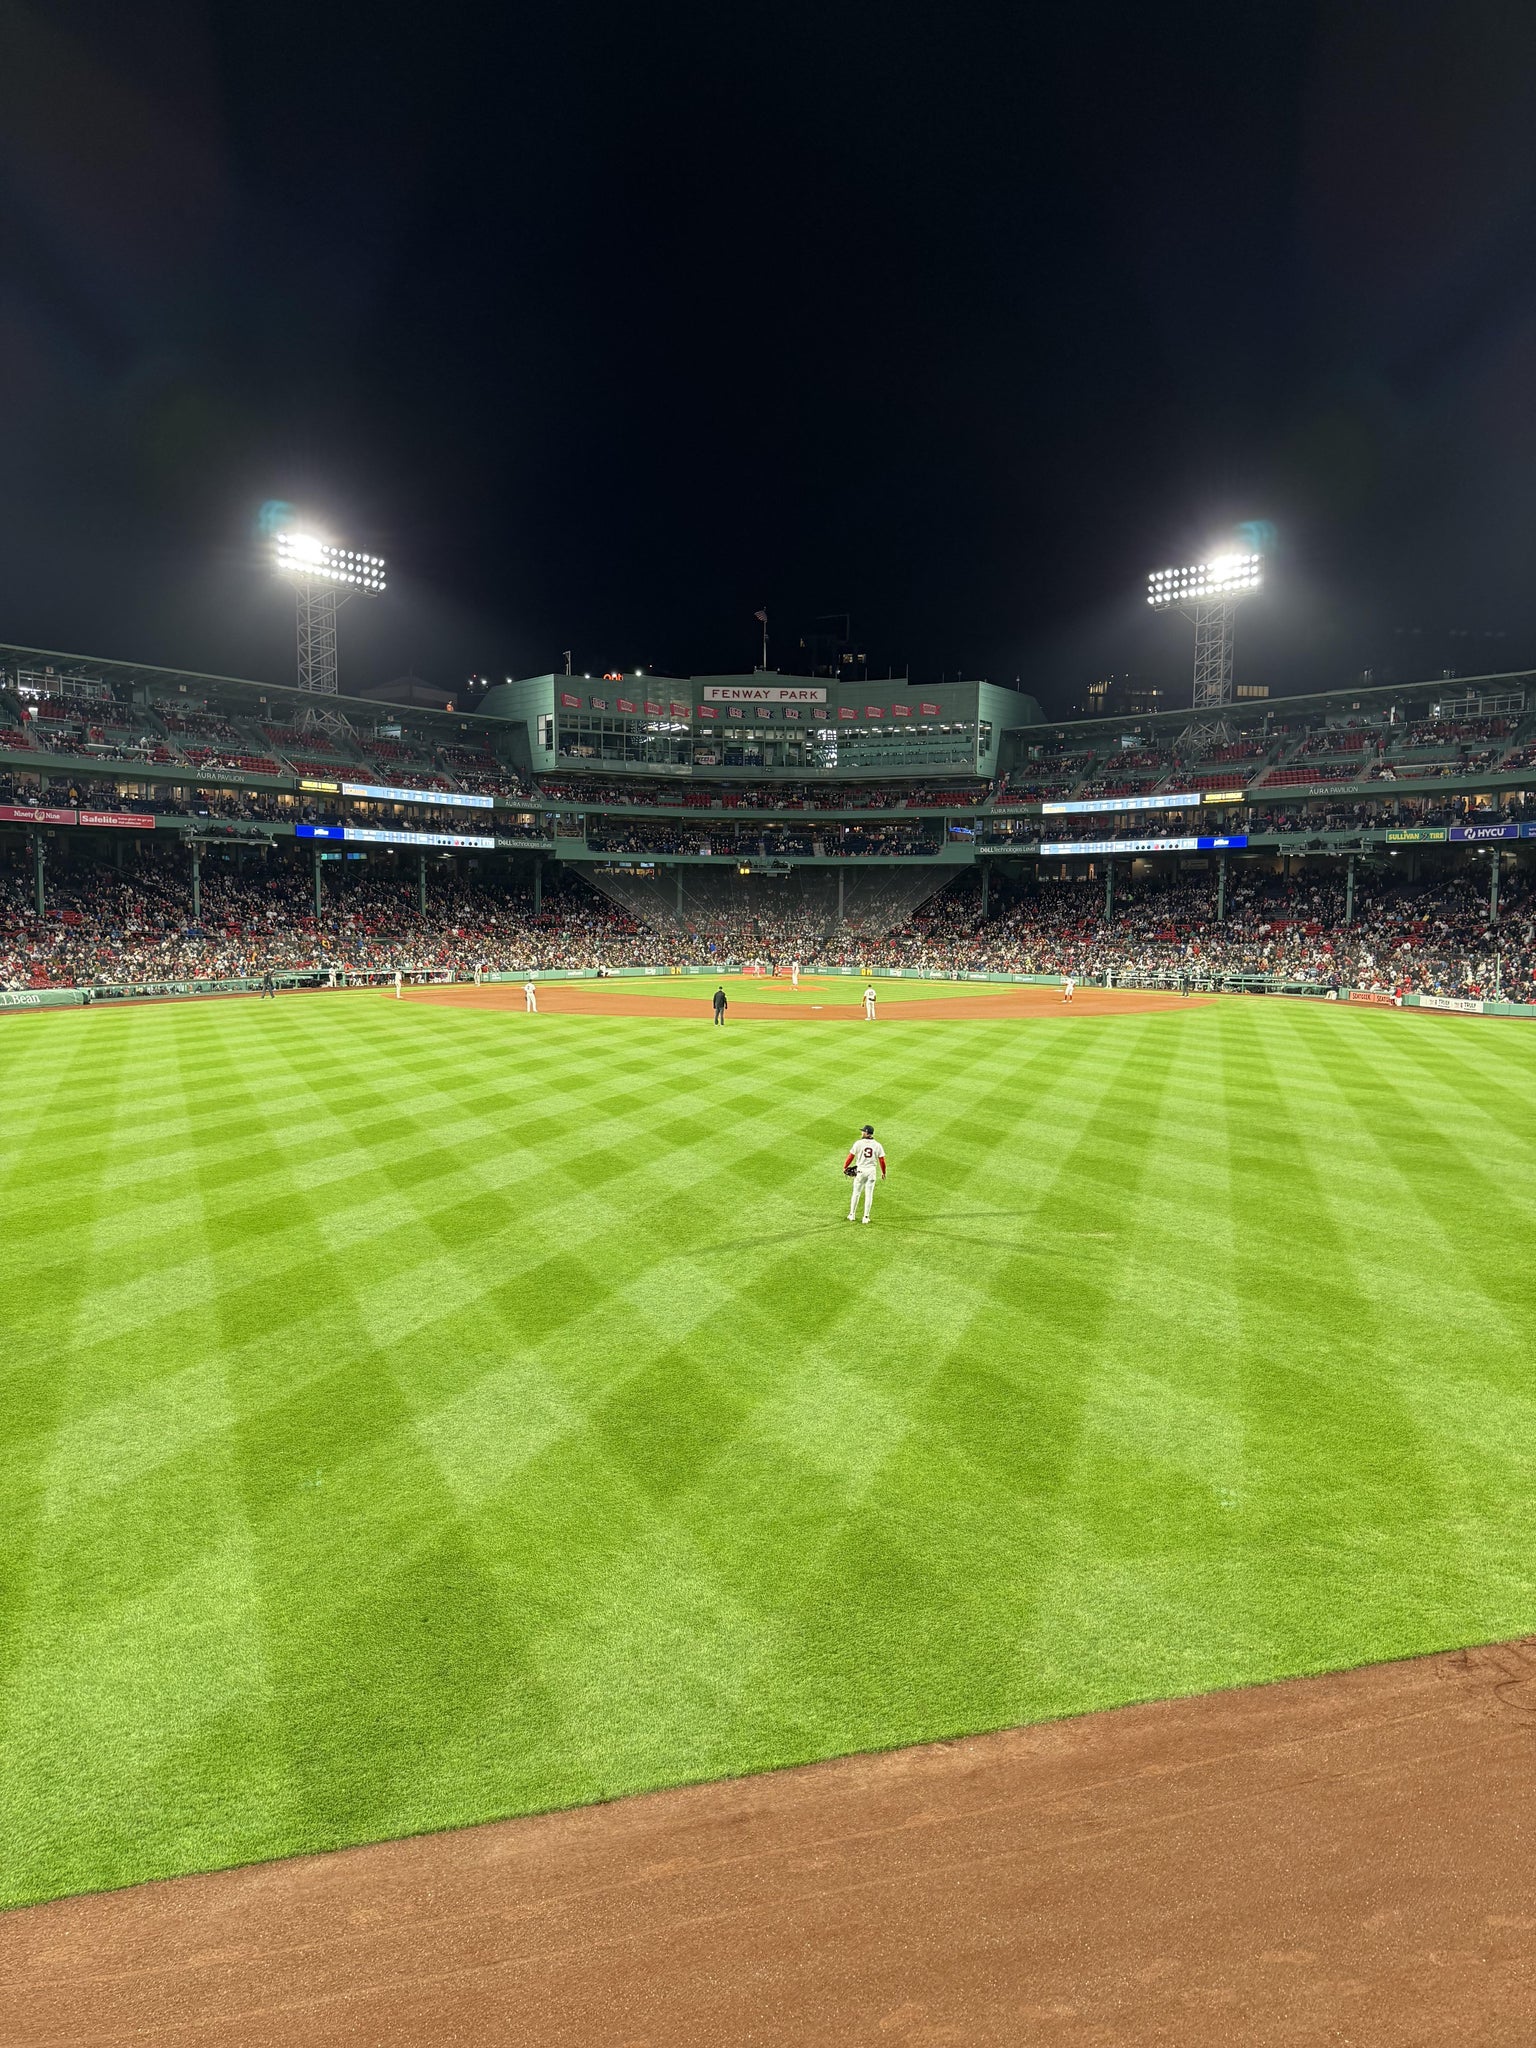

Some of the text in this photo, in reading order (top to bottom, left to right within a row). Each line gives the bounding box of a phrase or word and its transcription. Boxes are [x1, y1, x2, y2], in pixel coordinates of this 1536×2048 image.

[712, 689, 818, 700] FENWAY PARK
[217, 771, 245, 782] PAVILION
[1330, 785, 1359, 793] PAVILION
[14, 810, 61, 820] Ninety Nine
[82, 815, 118, 824] Safelite
[1388, 832, 1420, 840] SULLIVAN
[1477, 828, 1505, 838] HYCU
[498, 839, 512, 847] DELL
[863, 1147, 873, 1158] 3
